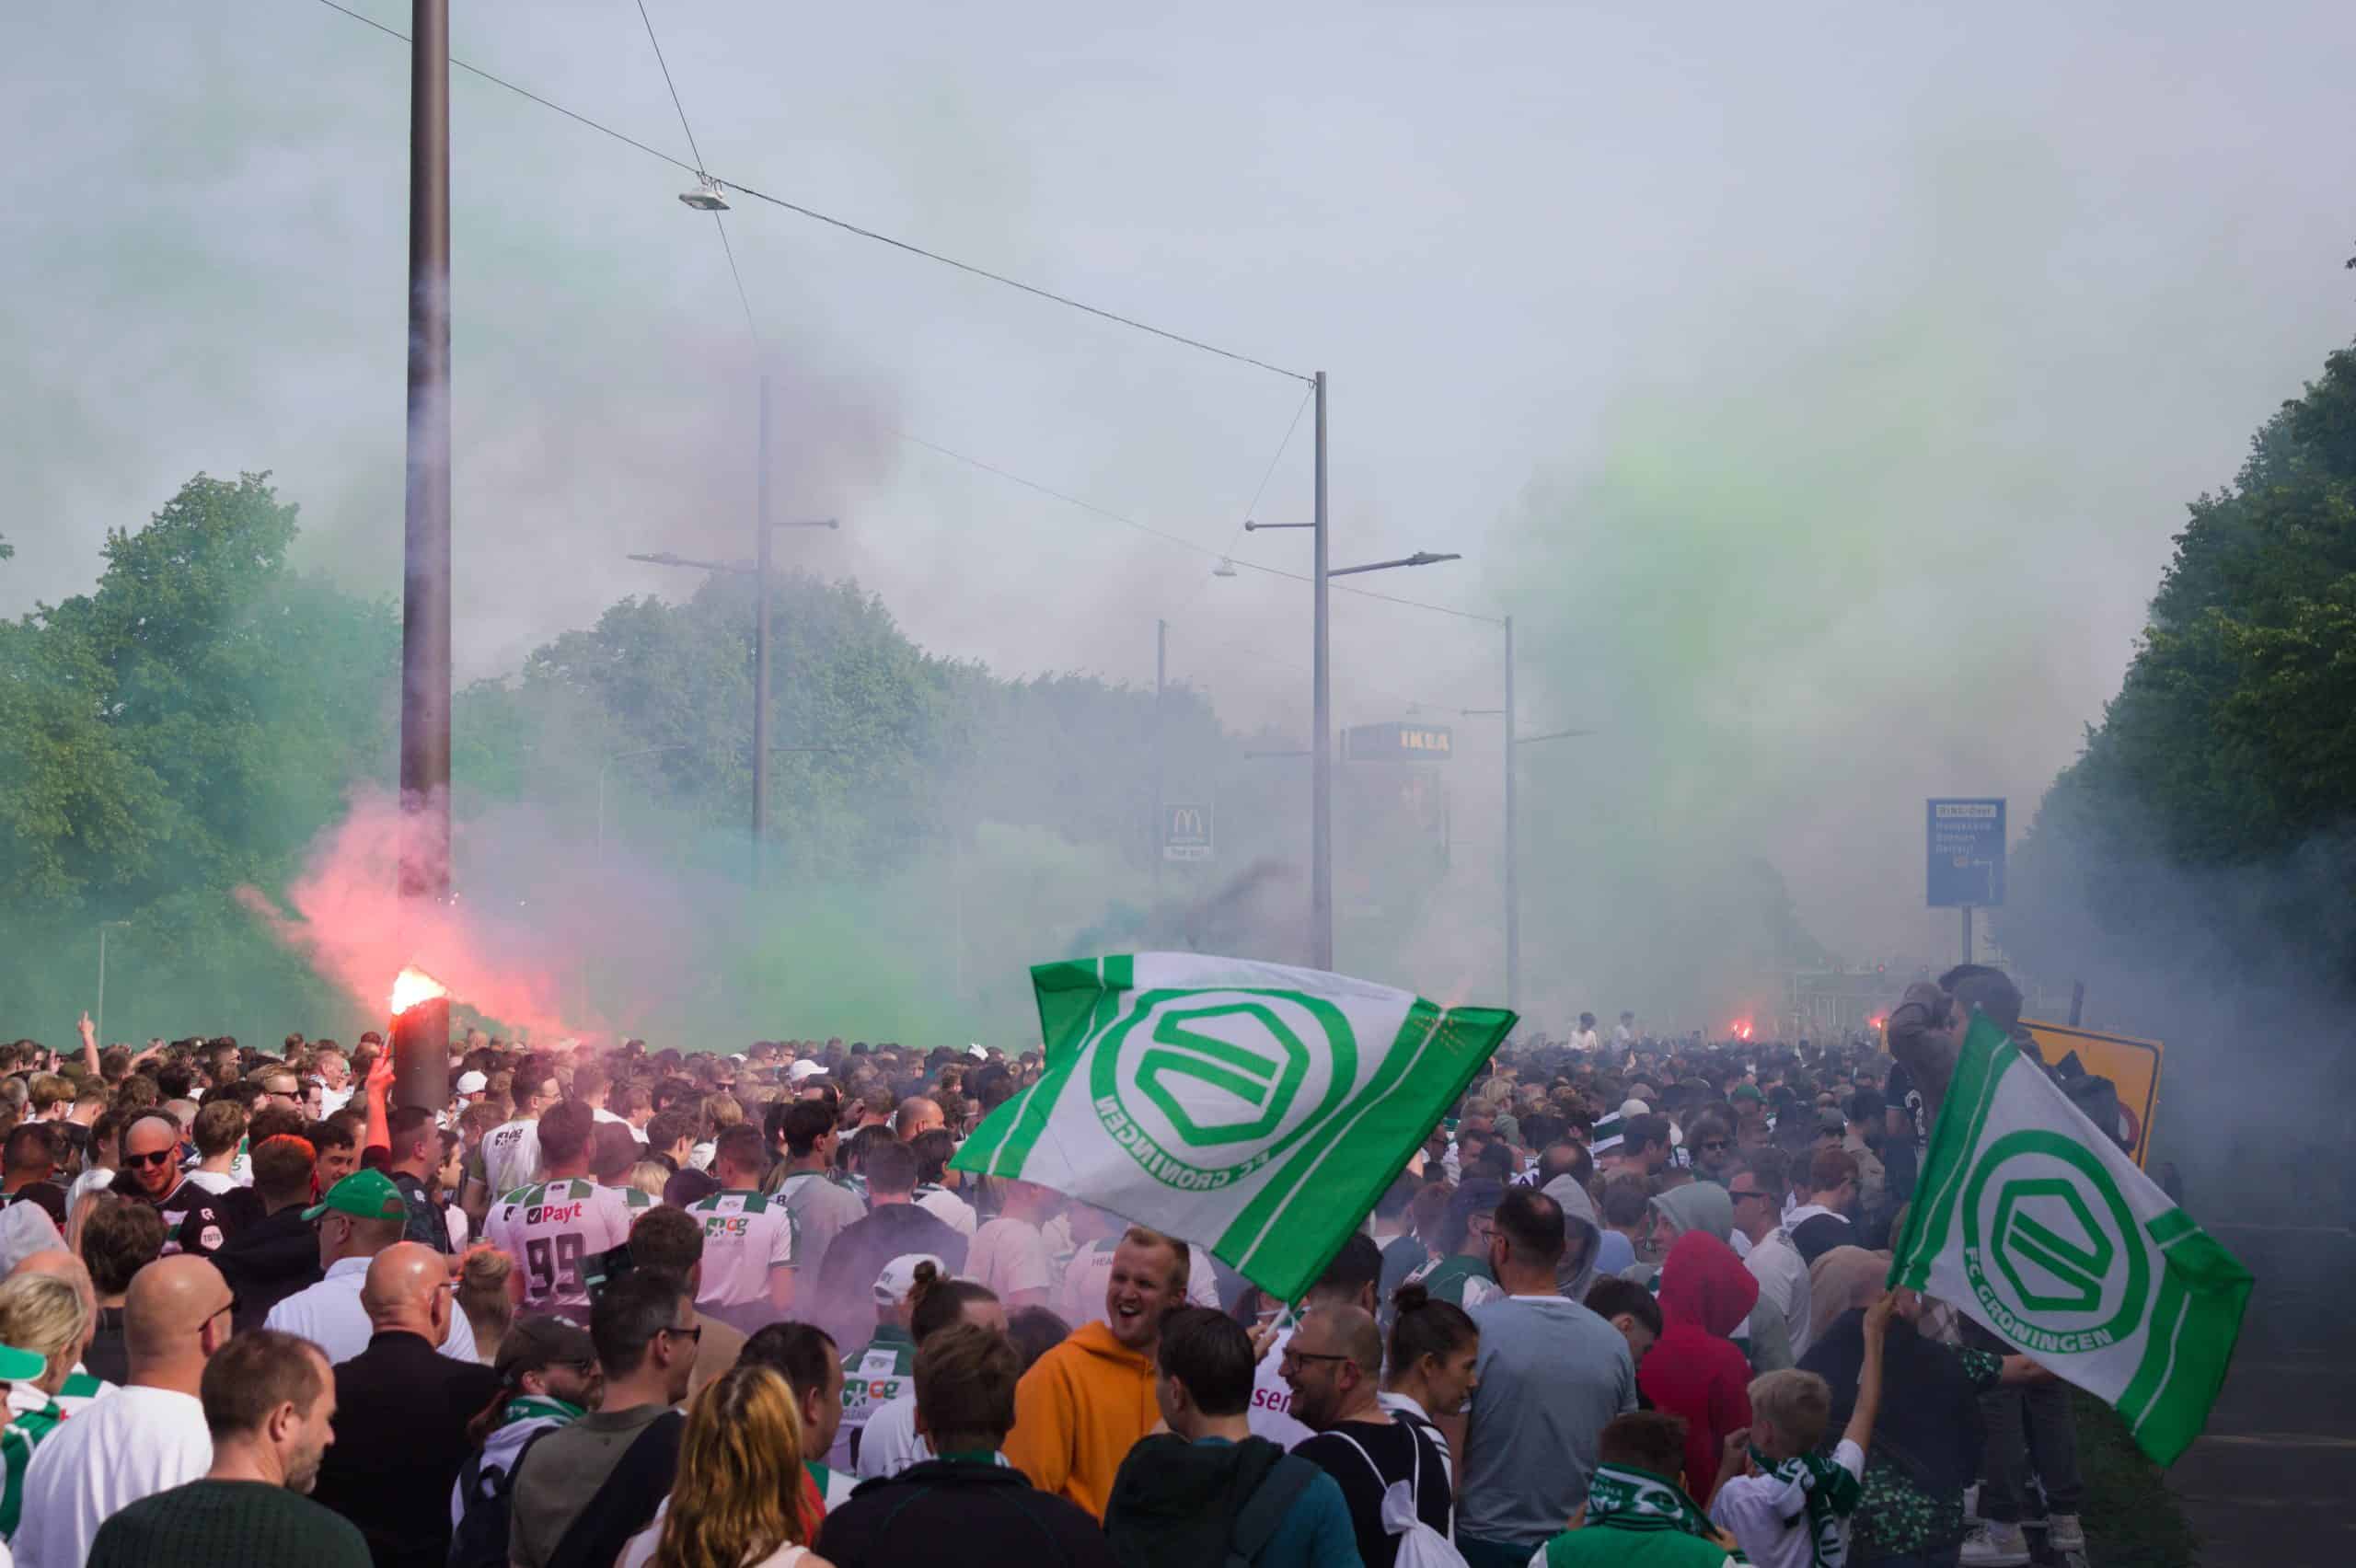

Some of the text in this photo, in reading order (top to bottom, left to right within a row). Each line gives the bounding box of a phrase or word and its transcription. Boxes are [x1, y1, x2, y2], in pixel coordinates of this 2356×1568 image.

[1400, 731, 1449, 751] IKEA
[542, 1202, 583, 1223] Payt
[525, 1232, 586, 1298] 99
[1966, 1247, 2114, 1352] FC GRONINGEN
